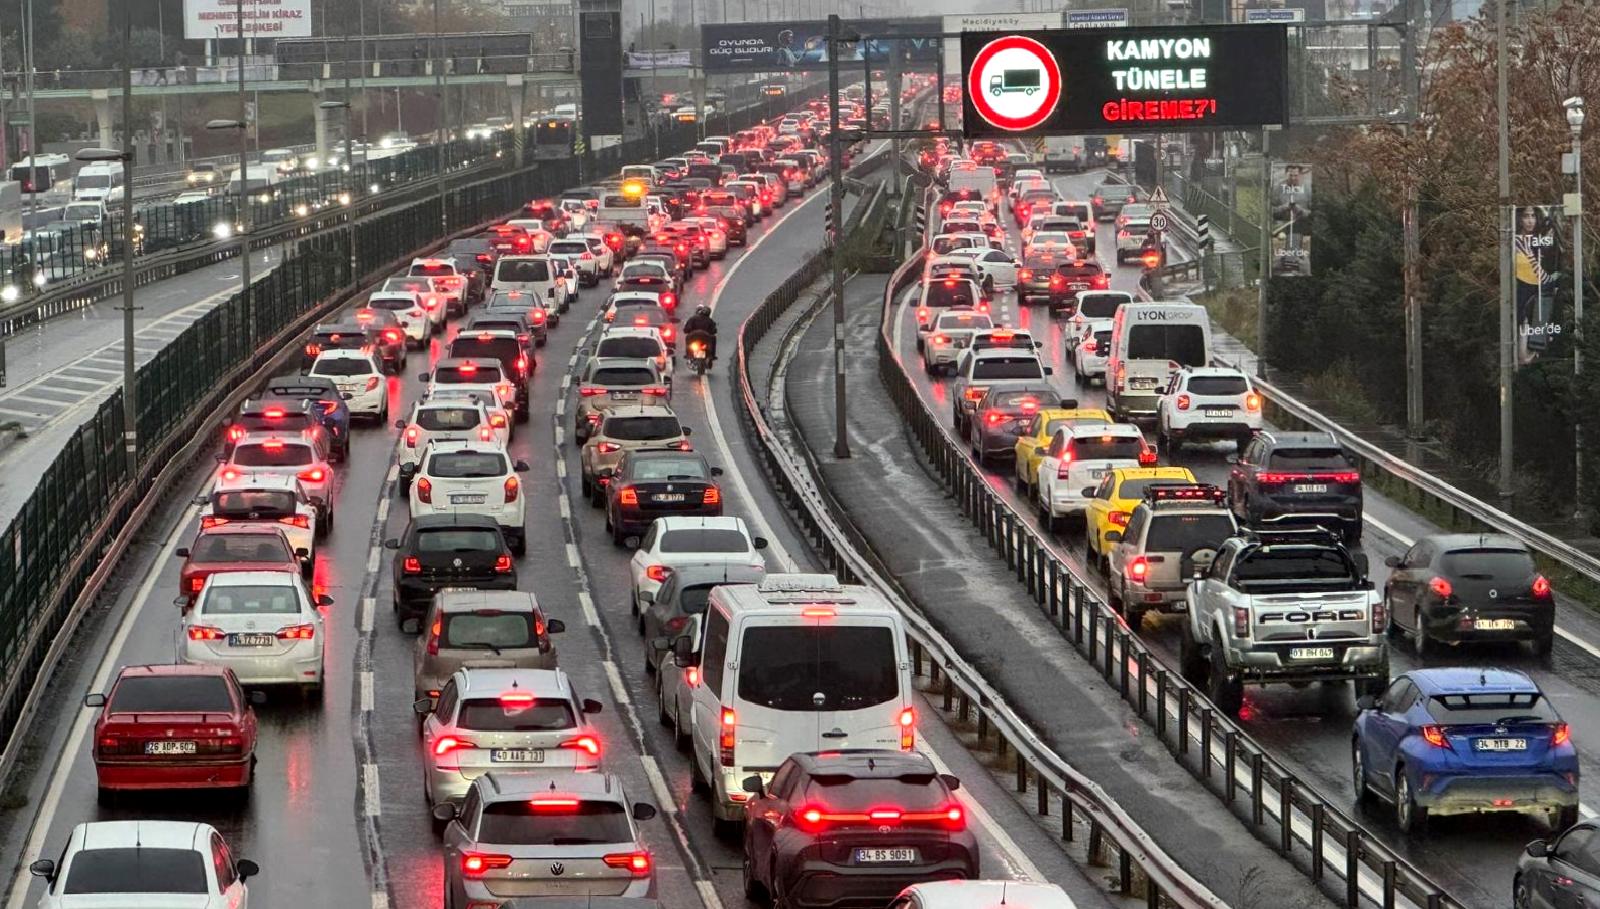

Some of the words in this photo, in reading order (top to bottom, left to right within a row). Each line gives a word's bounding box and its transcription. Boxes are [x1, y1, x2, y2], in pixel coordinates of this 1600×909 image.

[272, 8, 303, 19] KİRAZ
[719, 38, 764, 46] OYUNDA
[709, 47, 732, 55] GÜÇ
[1106, 37, 1211, 61] KAMYON
[1111, 66, 1206, 90] TÜNELE
[1153, 216, 1165, 227] 30
[1527, 234, 1554, 247] Taksi
[1274, 247, 1310, 257] Uber'de
[1137, 310, 1166, 321] LYON
[1519, 322, 1561, 336] Uber'de
[1259, 609, 1364, 625] FORD
[149, 742, 159, 751] 26
[497, 751, 508, 761] 40
[860, 850, 871, 860] 34
[875, 850, 886, 860] BS
[889, 849, 912, 860] 9091
